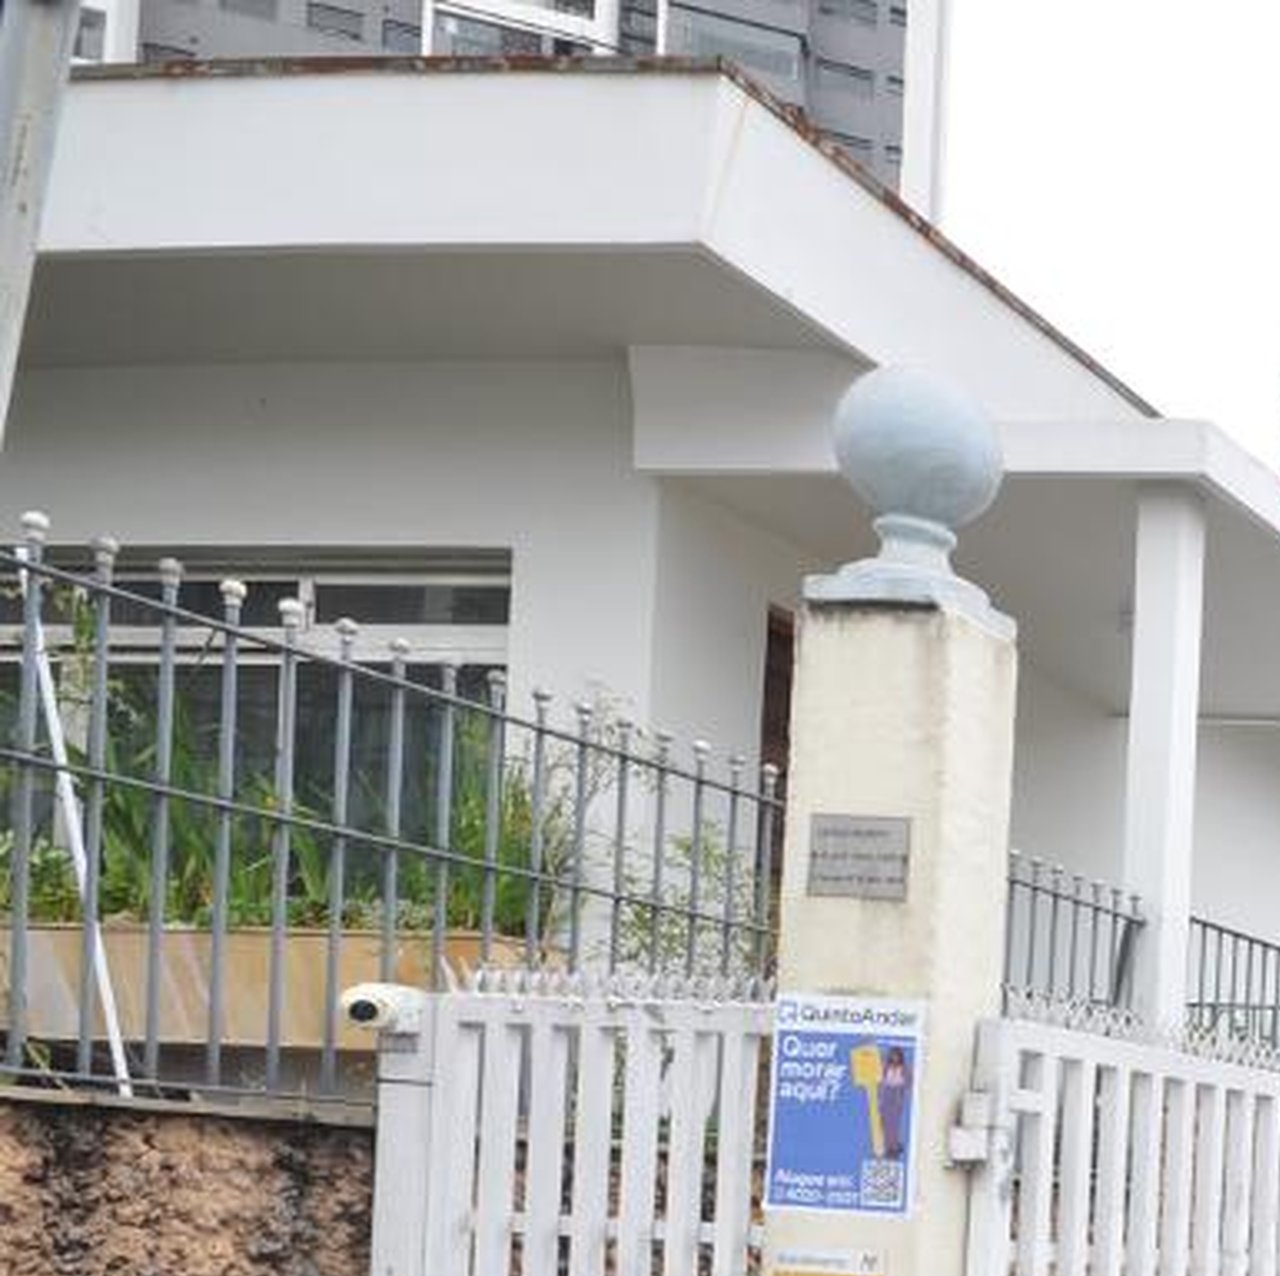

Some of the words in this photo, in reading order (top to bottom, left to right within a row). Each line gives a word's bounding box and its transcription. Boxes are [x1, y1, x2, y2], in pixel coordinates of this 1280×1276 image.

[801, 1006, 917, 1026] QuintoAndar
[779, 1060, 847, 1081] morar
[779, 1080, 840, 1104] aqui?
